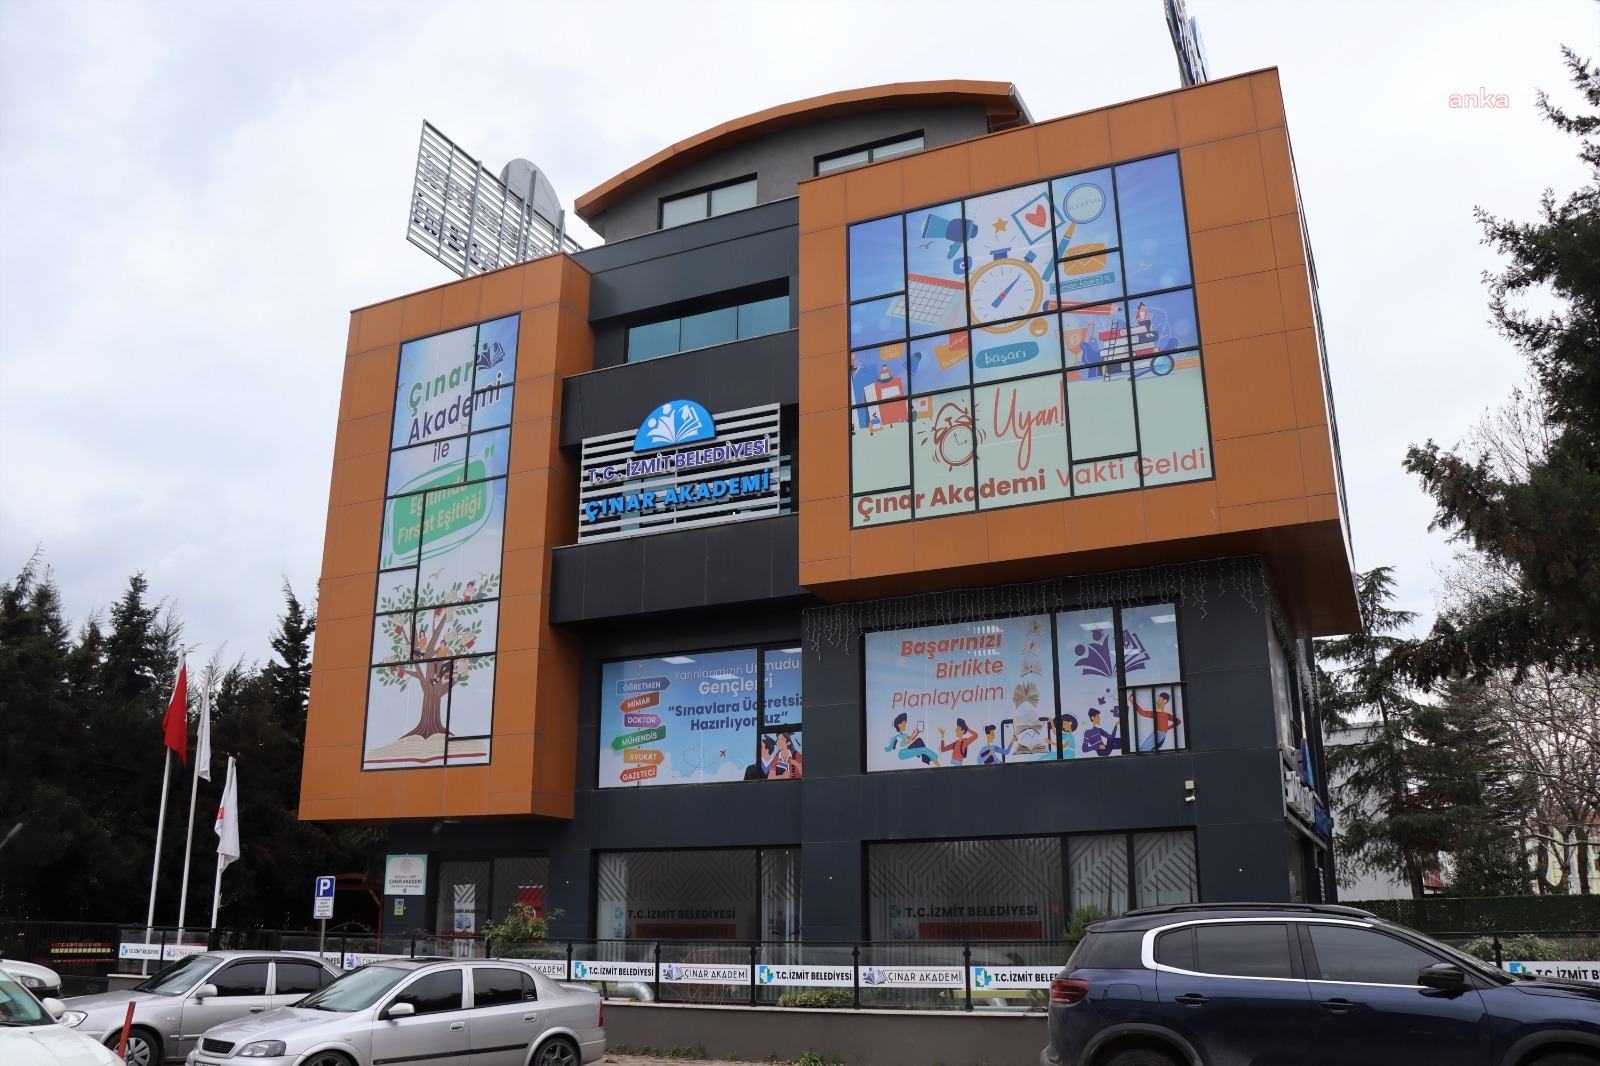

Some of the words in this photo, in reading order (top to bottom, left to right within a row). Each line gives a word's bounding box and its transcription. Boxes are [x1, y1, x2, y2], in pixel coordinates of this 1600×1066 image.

[985, 350, 1027, 365] başarı
[409, 359, 473, 417] Çınar
[408, 372, 502, 446] Akademi
[993, 380, 1065, 471] Uyan!
[433, 441, 450, 463] ile
[626, 453, 672, 477] İZMİT
[674, 434, 771, 469] BELEDİYESİ
[857, 492, 925, 523] Çınar
[930, 468, 1046, 507] Akademi
[1055, 457, 1125, 487] Vakti
[1134, 447, 1206, 477] Geldi
[585, 491, 656, 522] ÇINAR
[663, 468, 771, 506] AKADEMİ
[437, 490, 482, 531] Eşitliği
[901, 633, 1002, 660] Başarınızı
[936, 657, 1004, 679] Birlikte
[623, 682, 661, 692] ÖĞRETMEN
[627, 697, 650, 709] MİMAR
[891, 684, 1004, 710] Planlayalım
[627, 716, 657, 724] DOKTOR
[622, 732, 657, 746] MÜHENDİS
[629, 753, 657, 761] AVUKAT
[622, 768, 656, 781] GAZETECİ
[320, 879, 330, 896] P
[967, 902, 1038, 917] BELEDİYESİ
[619, 966, 654, 976] BELEDİYESİ
[684, 969, 708, 979] ÇINAR
[711, 969, 748, 979] AKADEMİ
[811, 970, 852, 980] BELEDİYESİ
[888, 972, 916, 982] ÇINAR
[919, 971, 961, 982] AKADEMİ
